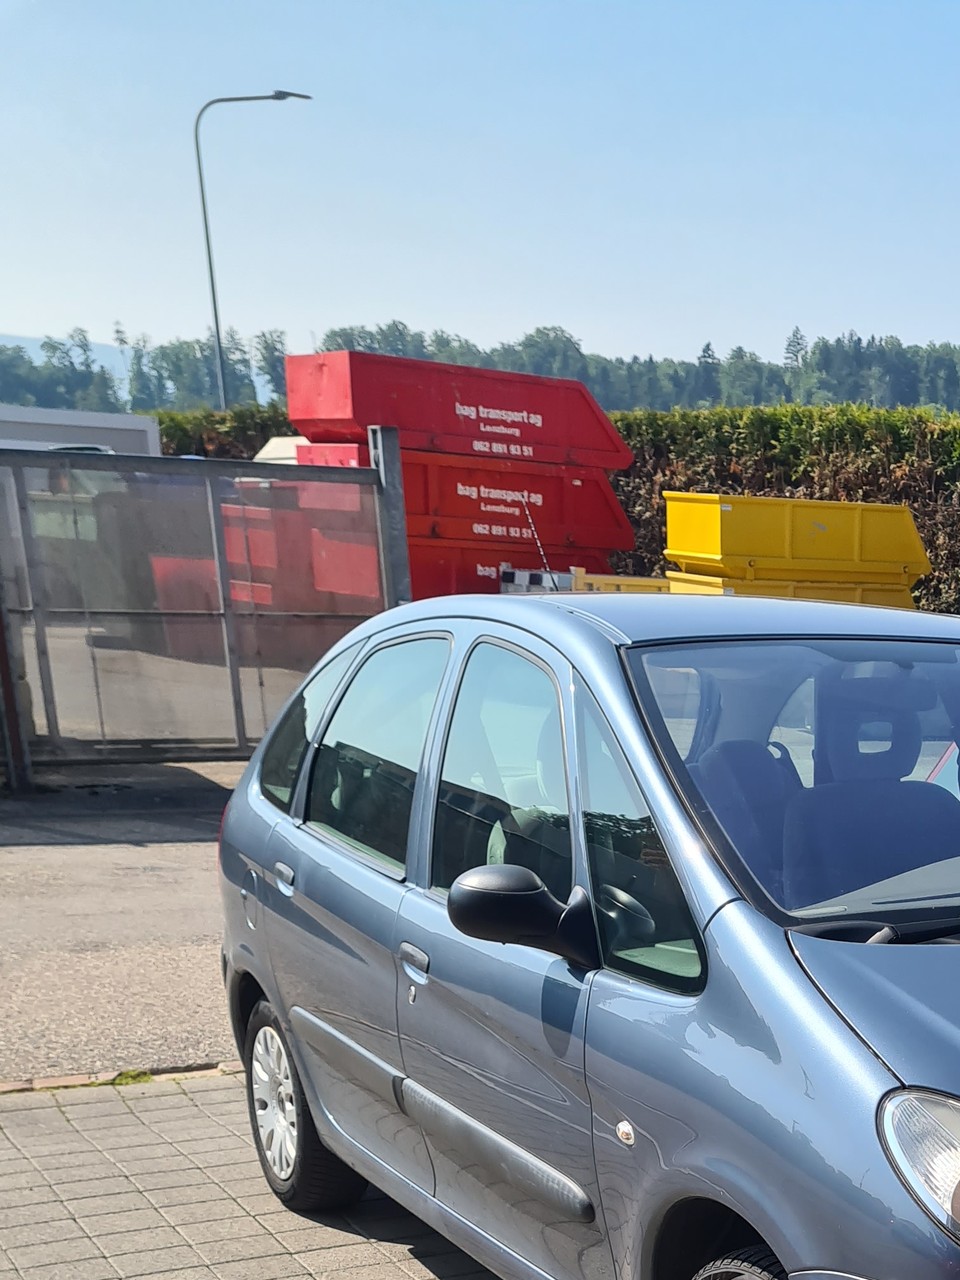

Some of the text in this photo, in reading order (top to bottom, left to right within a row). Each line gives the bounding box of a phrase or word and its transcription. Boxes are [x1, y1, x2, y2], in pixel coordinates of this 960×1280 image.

[455, 402, 542, 427] bag transport ag
[457, 482, 542, 506] bag transport ag
[476, 563, 497, 579] bag
